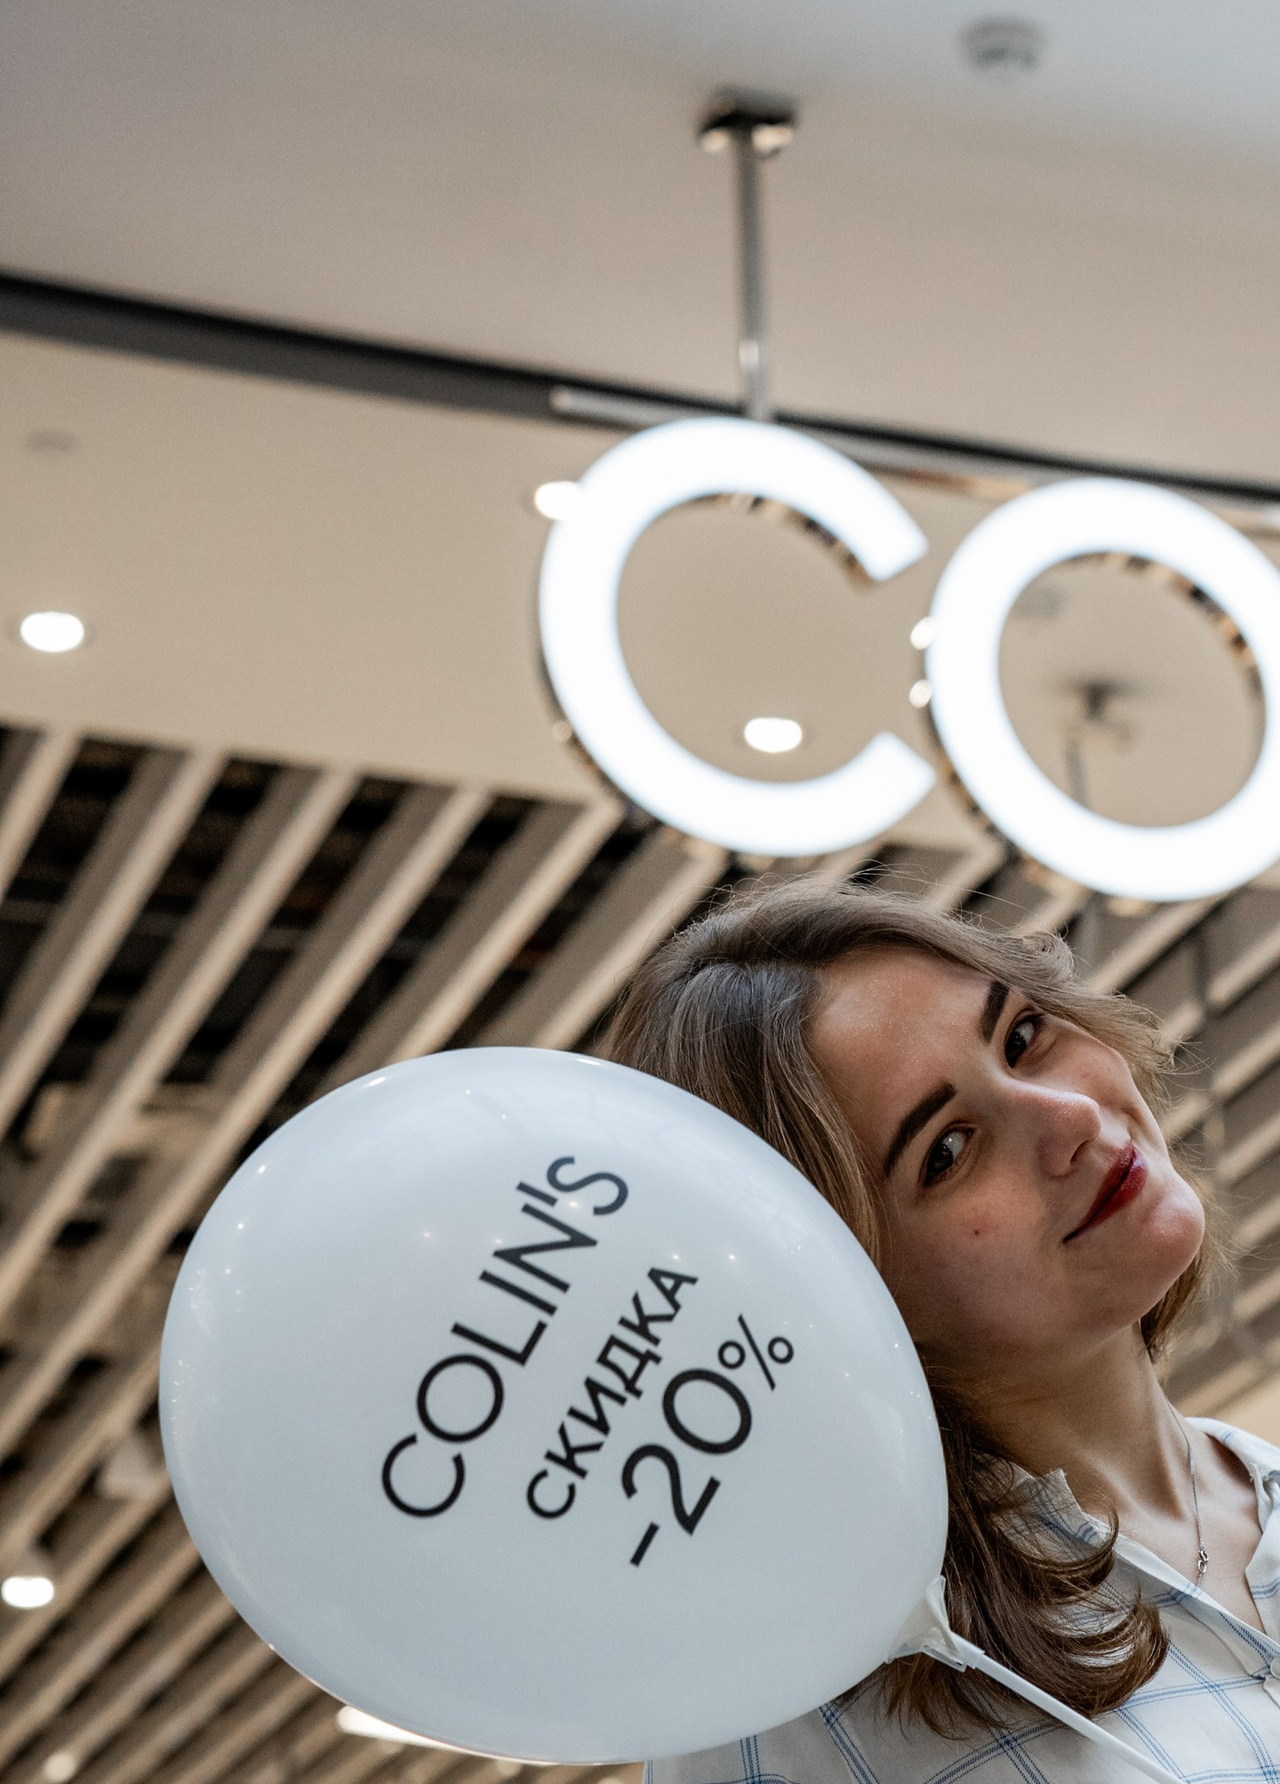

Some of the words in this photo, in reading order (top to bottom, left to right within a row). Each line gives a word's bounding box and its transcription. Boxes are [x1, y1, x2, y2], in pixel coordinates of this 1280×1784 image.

[382, 1156, 629, 1519] COLIN'S
[526, 1267, 699, 1520] СКИДКА
[621, 1314, 794, 1567] -20%
